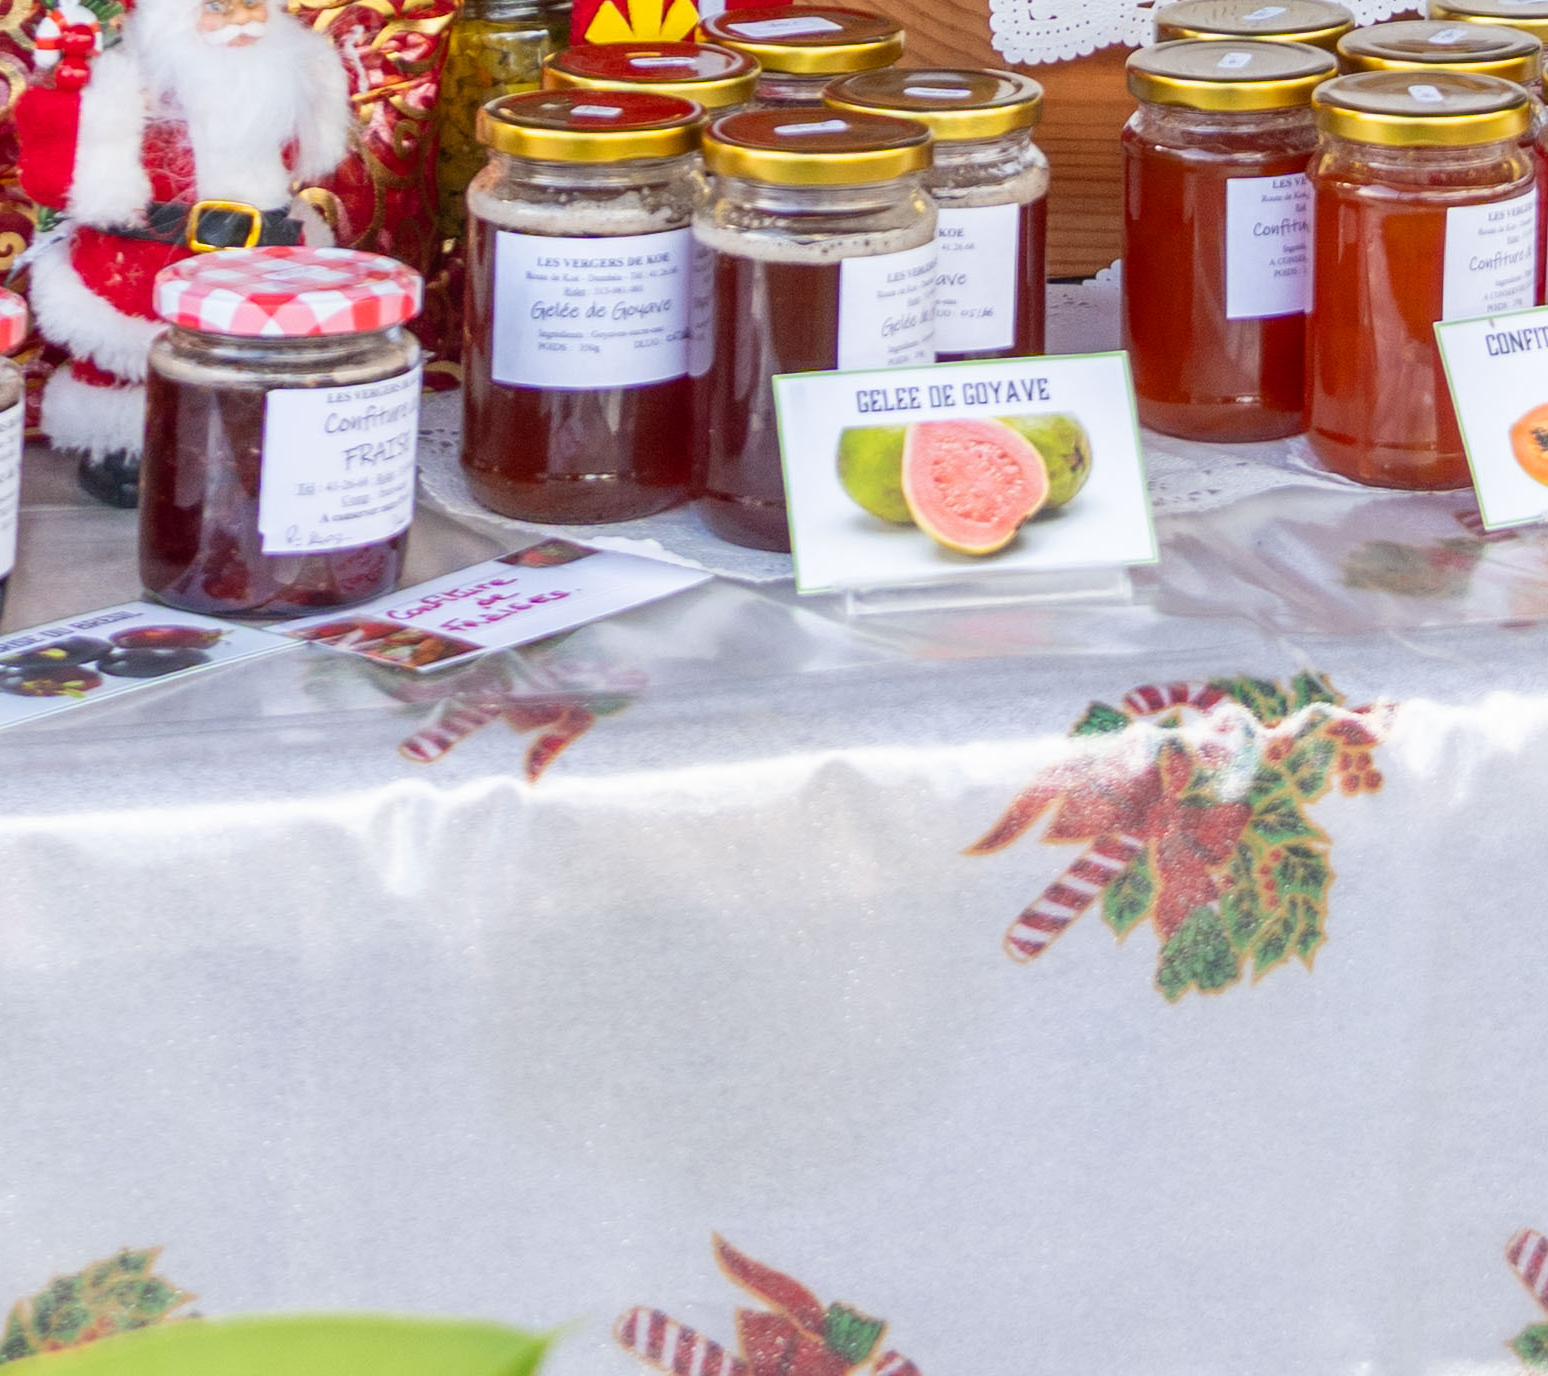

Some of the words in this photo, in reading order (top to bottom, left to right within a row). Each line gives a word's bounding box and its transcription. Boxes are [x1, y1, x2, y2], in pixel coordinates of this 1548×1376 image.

[1272, 179, 1293, 189] LES
[938, 227, 964, 238] KOE
[537, 257, 560, 267] LES
[564, 256, 624, 268] VERGERS
[627, 255, 642, 266] DE
[1468, 247, 1524, 272] Confiture
[530, 300, 580, 320] Gelée
[585, 302, 606, 318] de
[612, 299, 672, 320] Goyave
[881, 312, 916, 337] Gelée
[856, 385, 922, 414] GELEE
[929, 382, 957, 409] DE
[962, 376, 1050, 407] GOYAVE
[43, 625, 71, 640] DU
